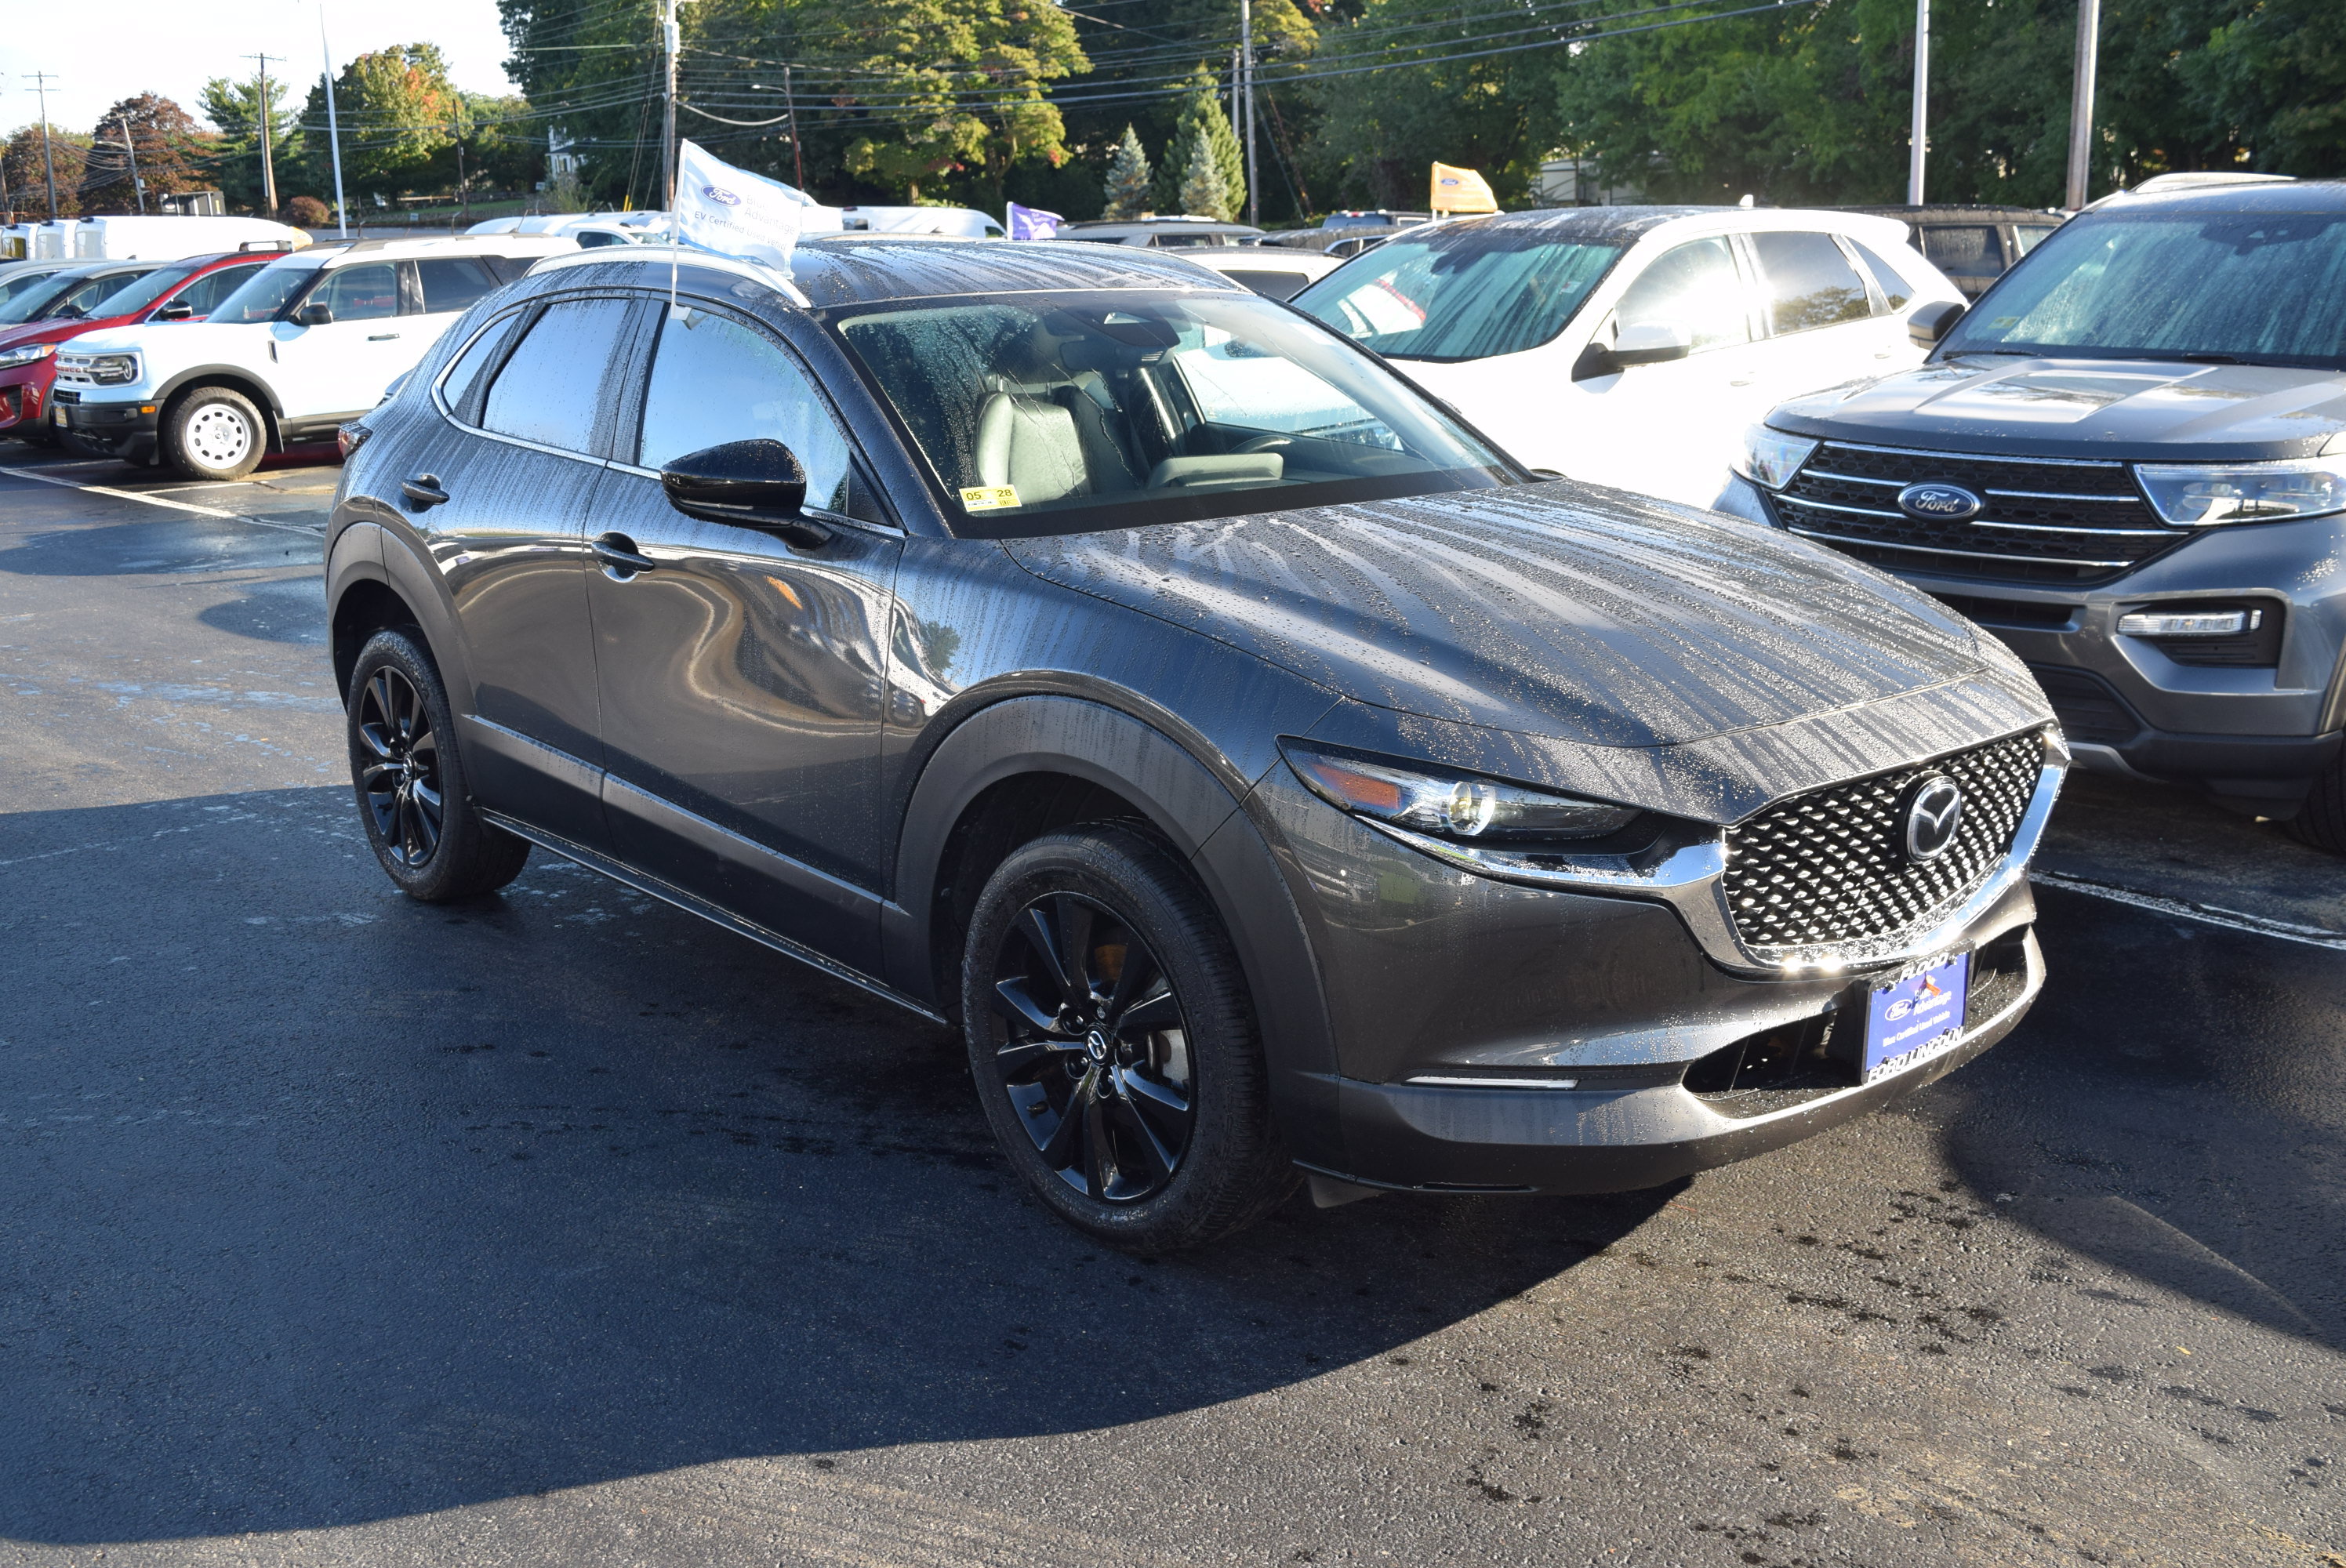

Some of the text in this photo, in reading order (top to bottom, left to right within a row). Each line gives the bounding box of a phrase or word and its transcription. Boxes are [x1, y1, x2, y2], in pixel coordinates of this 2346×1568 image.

[709, 187, 736, 205] Ford
[695, 210, 706, 220] EV
[709, 215, 745, 234] Certified
[746, 227, 765, 241] Used
[744, 208, 796, 235] Advantage
[966, 492, 982, 500] 05
[1916, 490, 1959, 512] Ford
[1899, 952, 1949, 983] FLOOD
[1867, 1025, 1963, 1083] FORD LINCOLN
